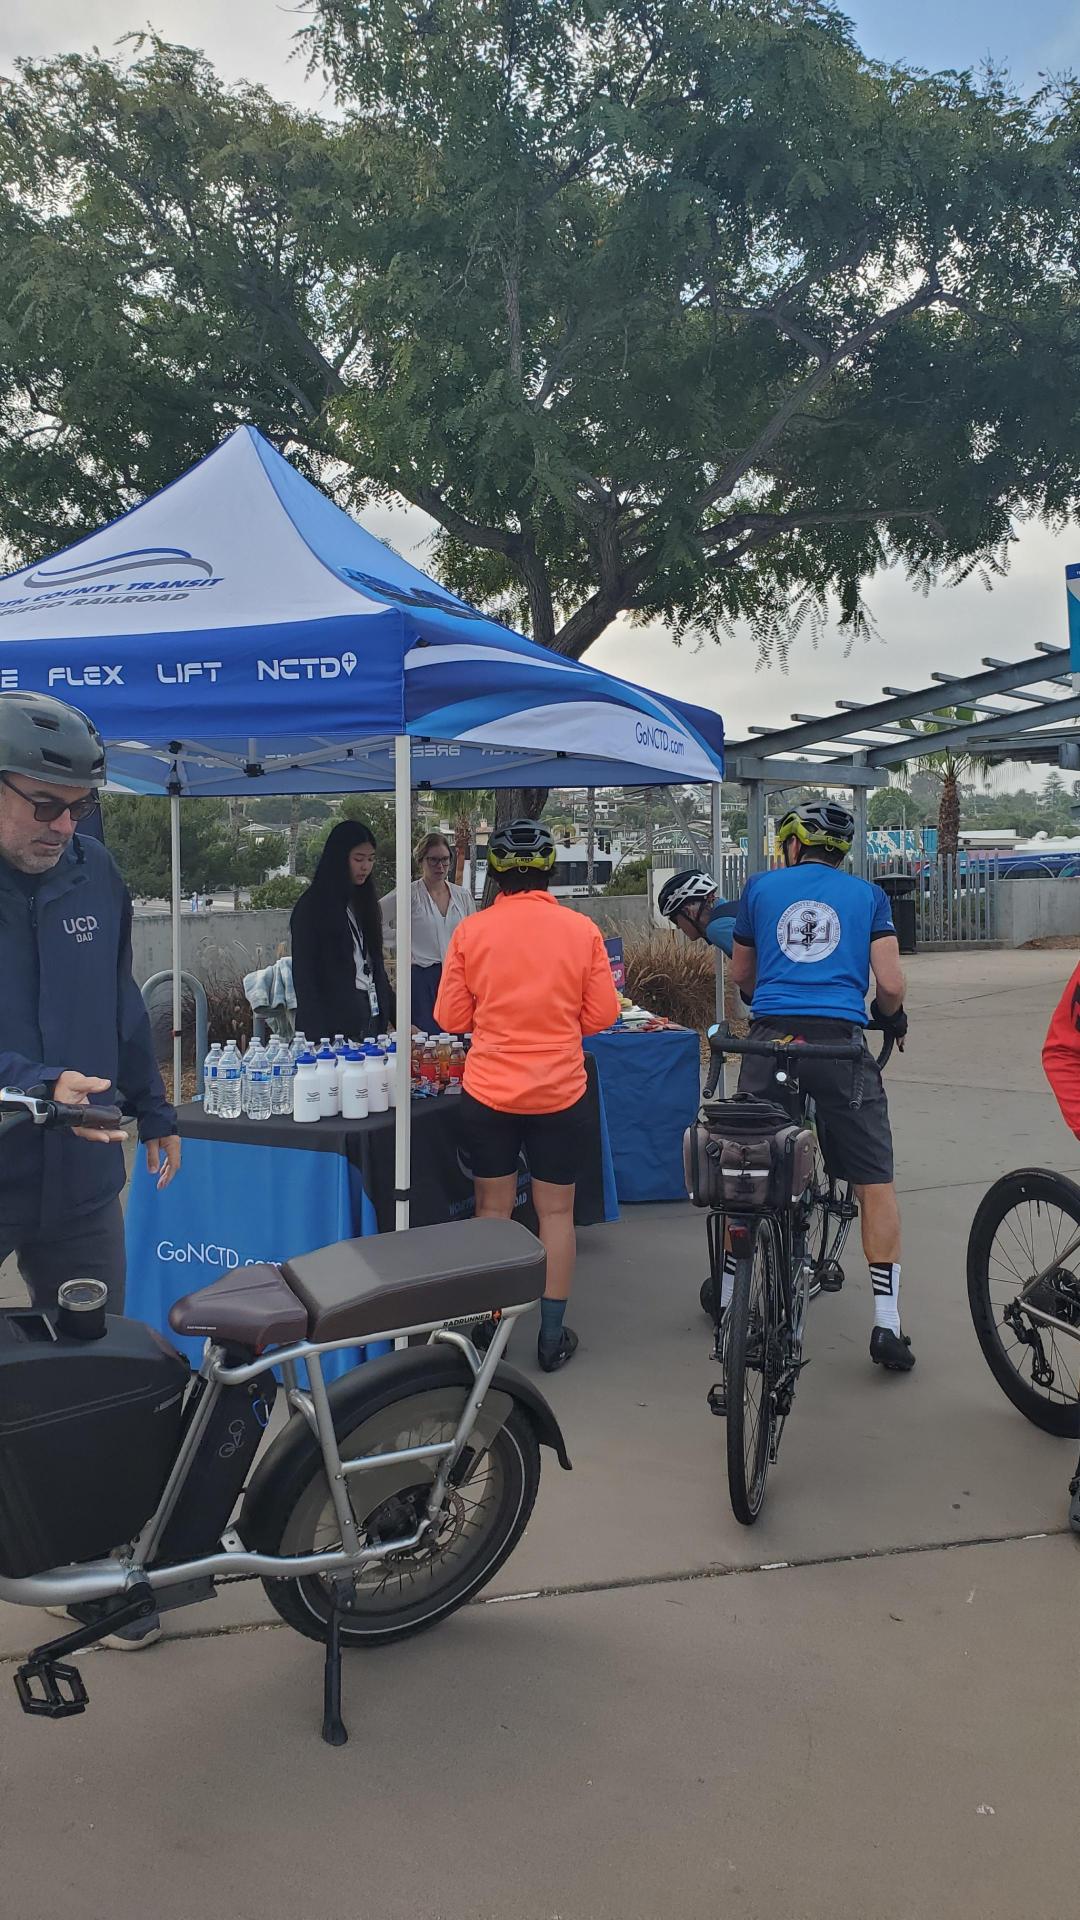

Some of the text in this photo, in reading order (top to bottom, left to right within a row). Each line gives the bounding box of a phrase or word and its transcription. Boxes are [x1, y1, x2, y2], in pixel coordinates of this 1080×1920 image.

[33, 583, 124, 602] COUNTY
[126, 577, 225, 591] TRANSIT
[67, 593, 190, 606] RAILROAD
[48, 665, 125, 687] FLEX
[157, 661, 222, 684] LIFT
[257, 657, 341, 681] NCTD
[635, 721, 685, 756] GoNCTD.com
[63, 915, 98, 934] UCD
[76, 931, 93, 943] DAD
[442, 1313, 491, 1328] RADRUNNER
